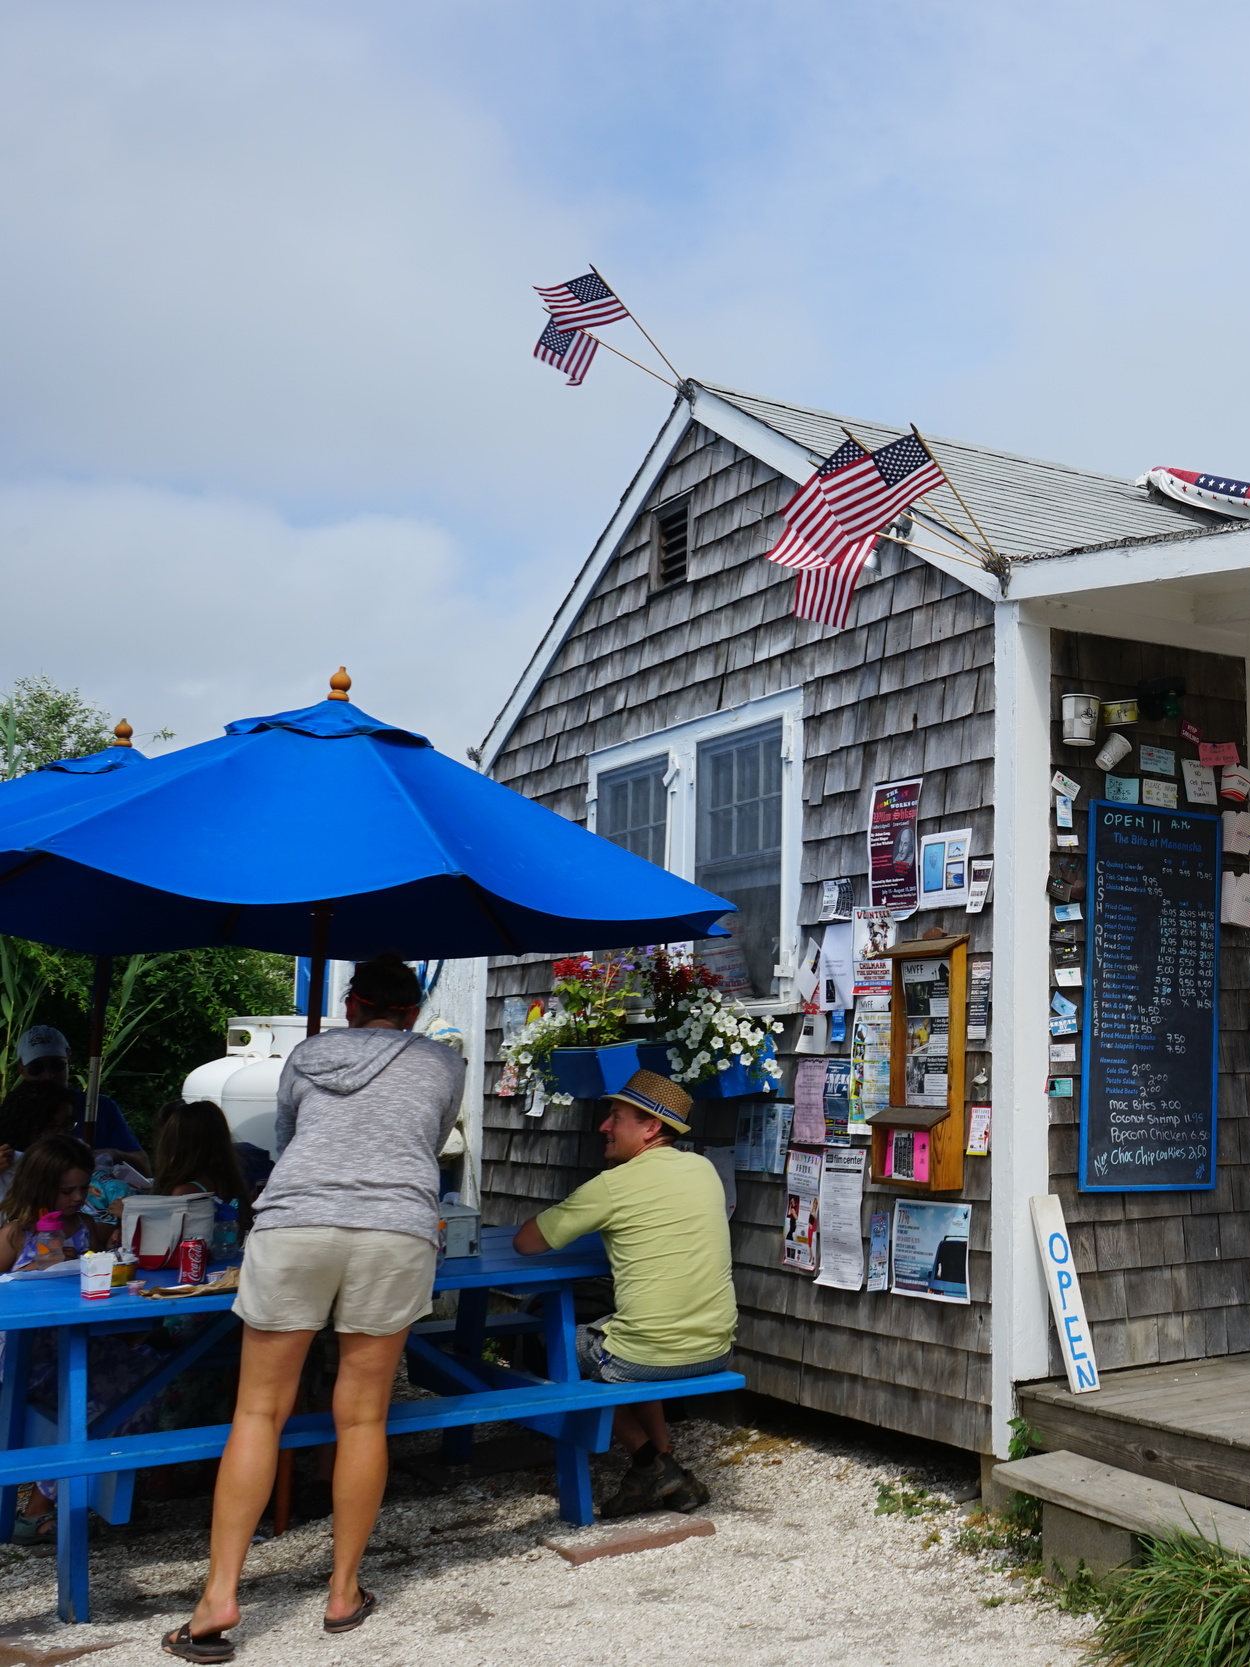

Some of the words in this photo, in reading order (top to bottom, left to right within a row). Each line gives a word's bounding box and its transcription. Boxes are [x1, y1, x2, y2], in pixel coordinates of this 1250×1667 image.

[1103, 812, 1145, 828] OPEN
[1113, 832, 1129, 844] The
[1131, 834, 1148, 846] Bite
[1149, 838, 1158, 847] at
[1160, 838, 1203, 853] Menemsha
[1132, 1098, 1157, 1111] Bites
[1109, 1112, 1145, 1123] Coconut
[1146, 1114, 1180, 1128] Shrimp
[1149, 1127, 1188, 1141] Chicken
[833, 1154, 843, 1164] film
[843, 1156, 863, 1165] center
[187, 1244, 202, 1282] Coca-Cola
[1048, 1232, 1097, 1389] OPEN
